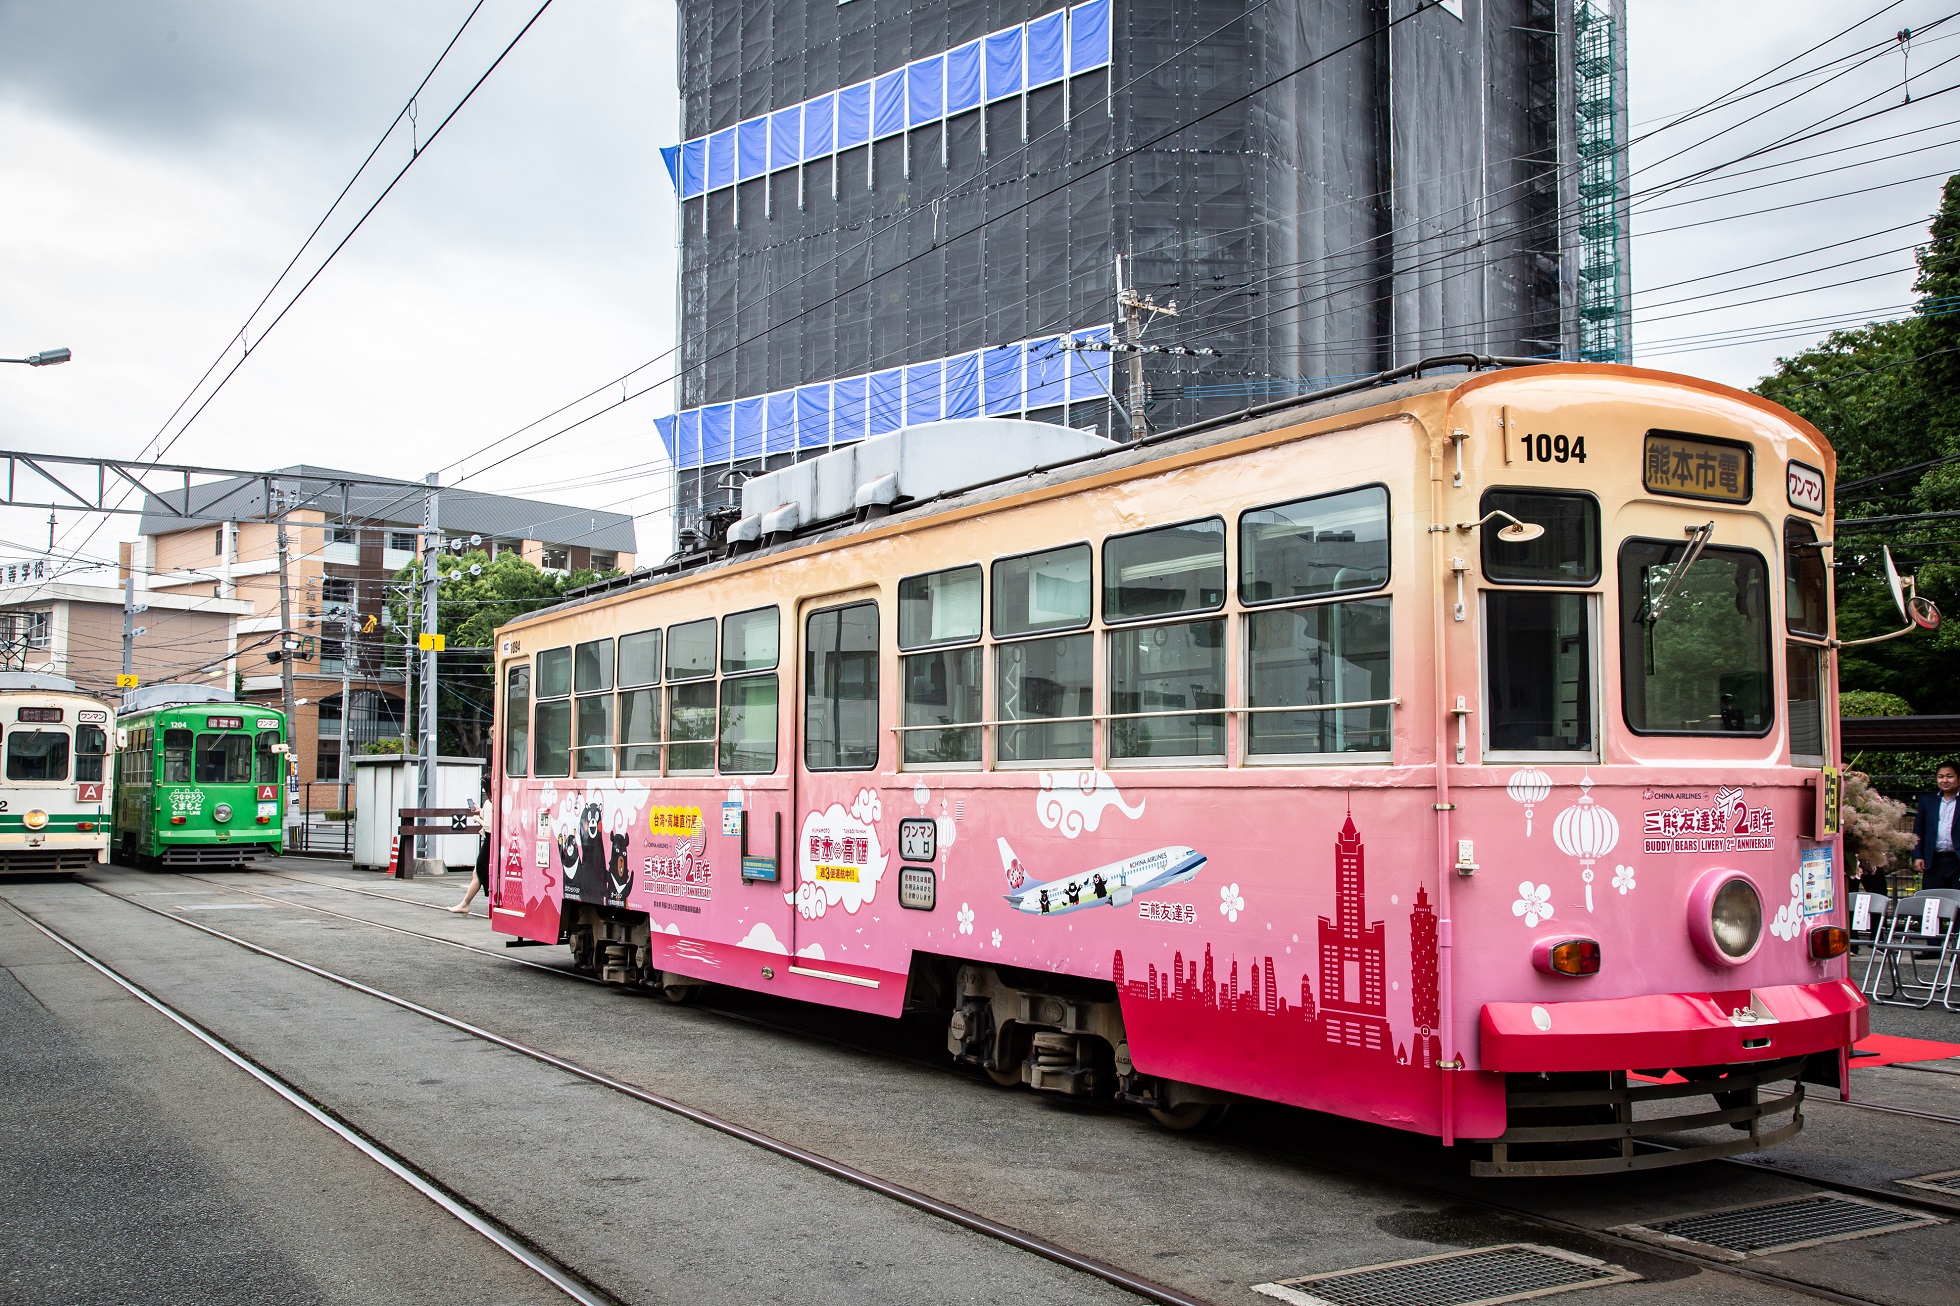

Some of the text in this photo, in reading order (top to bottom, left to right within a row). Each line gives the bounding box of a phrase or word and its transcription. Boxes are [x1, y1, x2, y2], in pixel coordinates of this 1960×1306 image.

[1521, 434, 1587, 463] 1094
[1647, 444, 1740, 493] 熊本市電
[1789, 472, 1821, 502] ワンマン
[510, 640, 521, 654] 1094
[124, 677, 132, 686] 2
[84, 785, 97, 798] A
[262, 786, 273, 798] A
[171, 802, 202, 811] くまもと
[1733, 802, 1774, 833] 2周年
[904, 825, 933, 838] ワンマン
[810, 836, 868, 864] 熊本 高雄
[907, 841, 930, 855] 入口
[1645, 838, 1774, 852] BUDDY BEARS LIVERY 2nd ANNIVERSARY
[1131, 858, 1147, 868] CHINA
[1147, 853, 1168, 864] AIRLINES
[685, 853, 712, 883] 2周年
[904, 883, 931, 893] の持込みはかた
[904, 892, 931, 901] くお断りします
[1139, 903, 1195, 923] 三熊友達号
